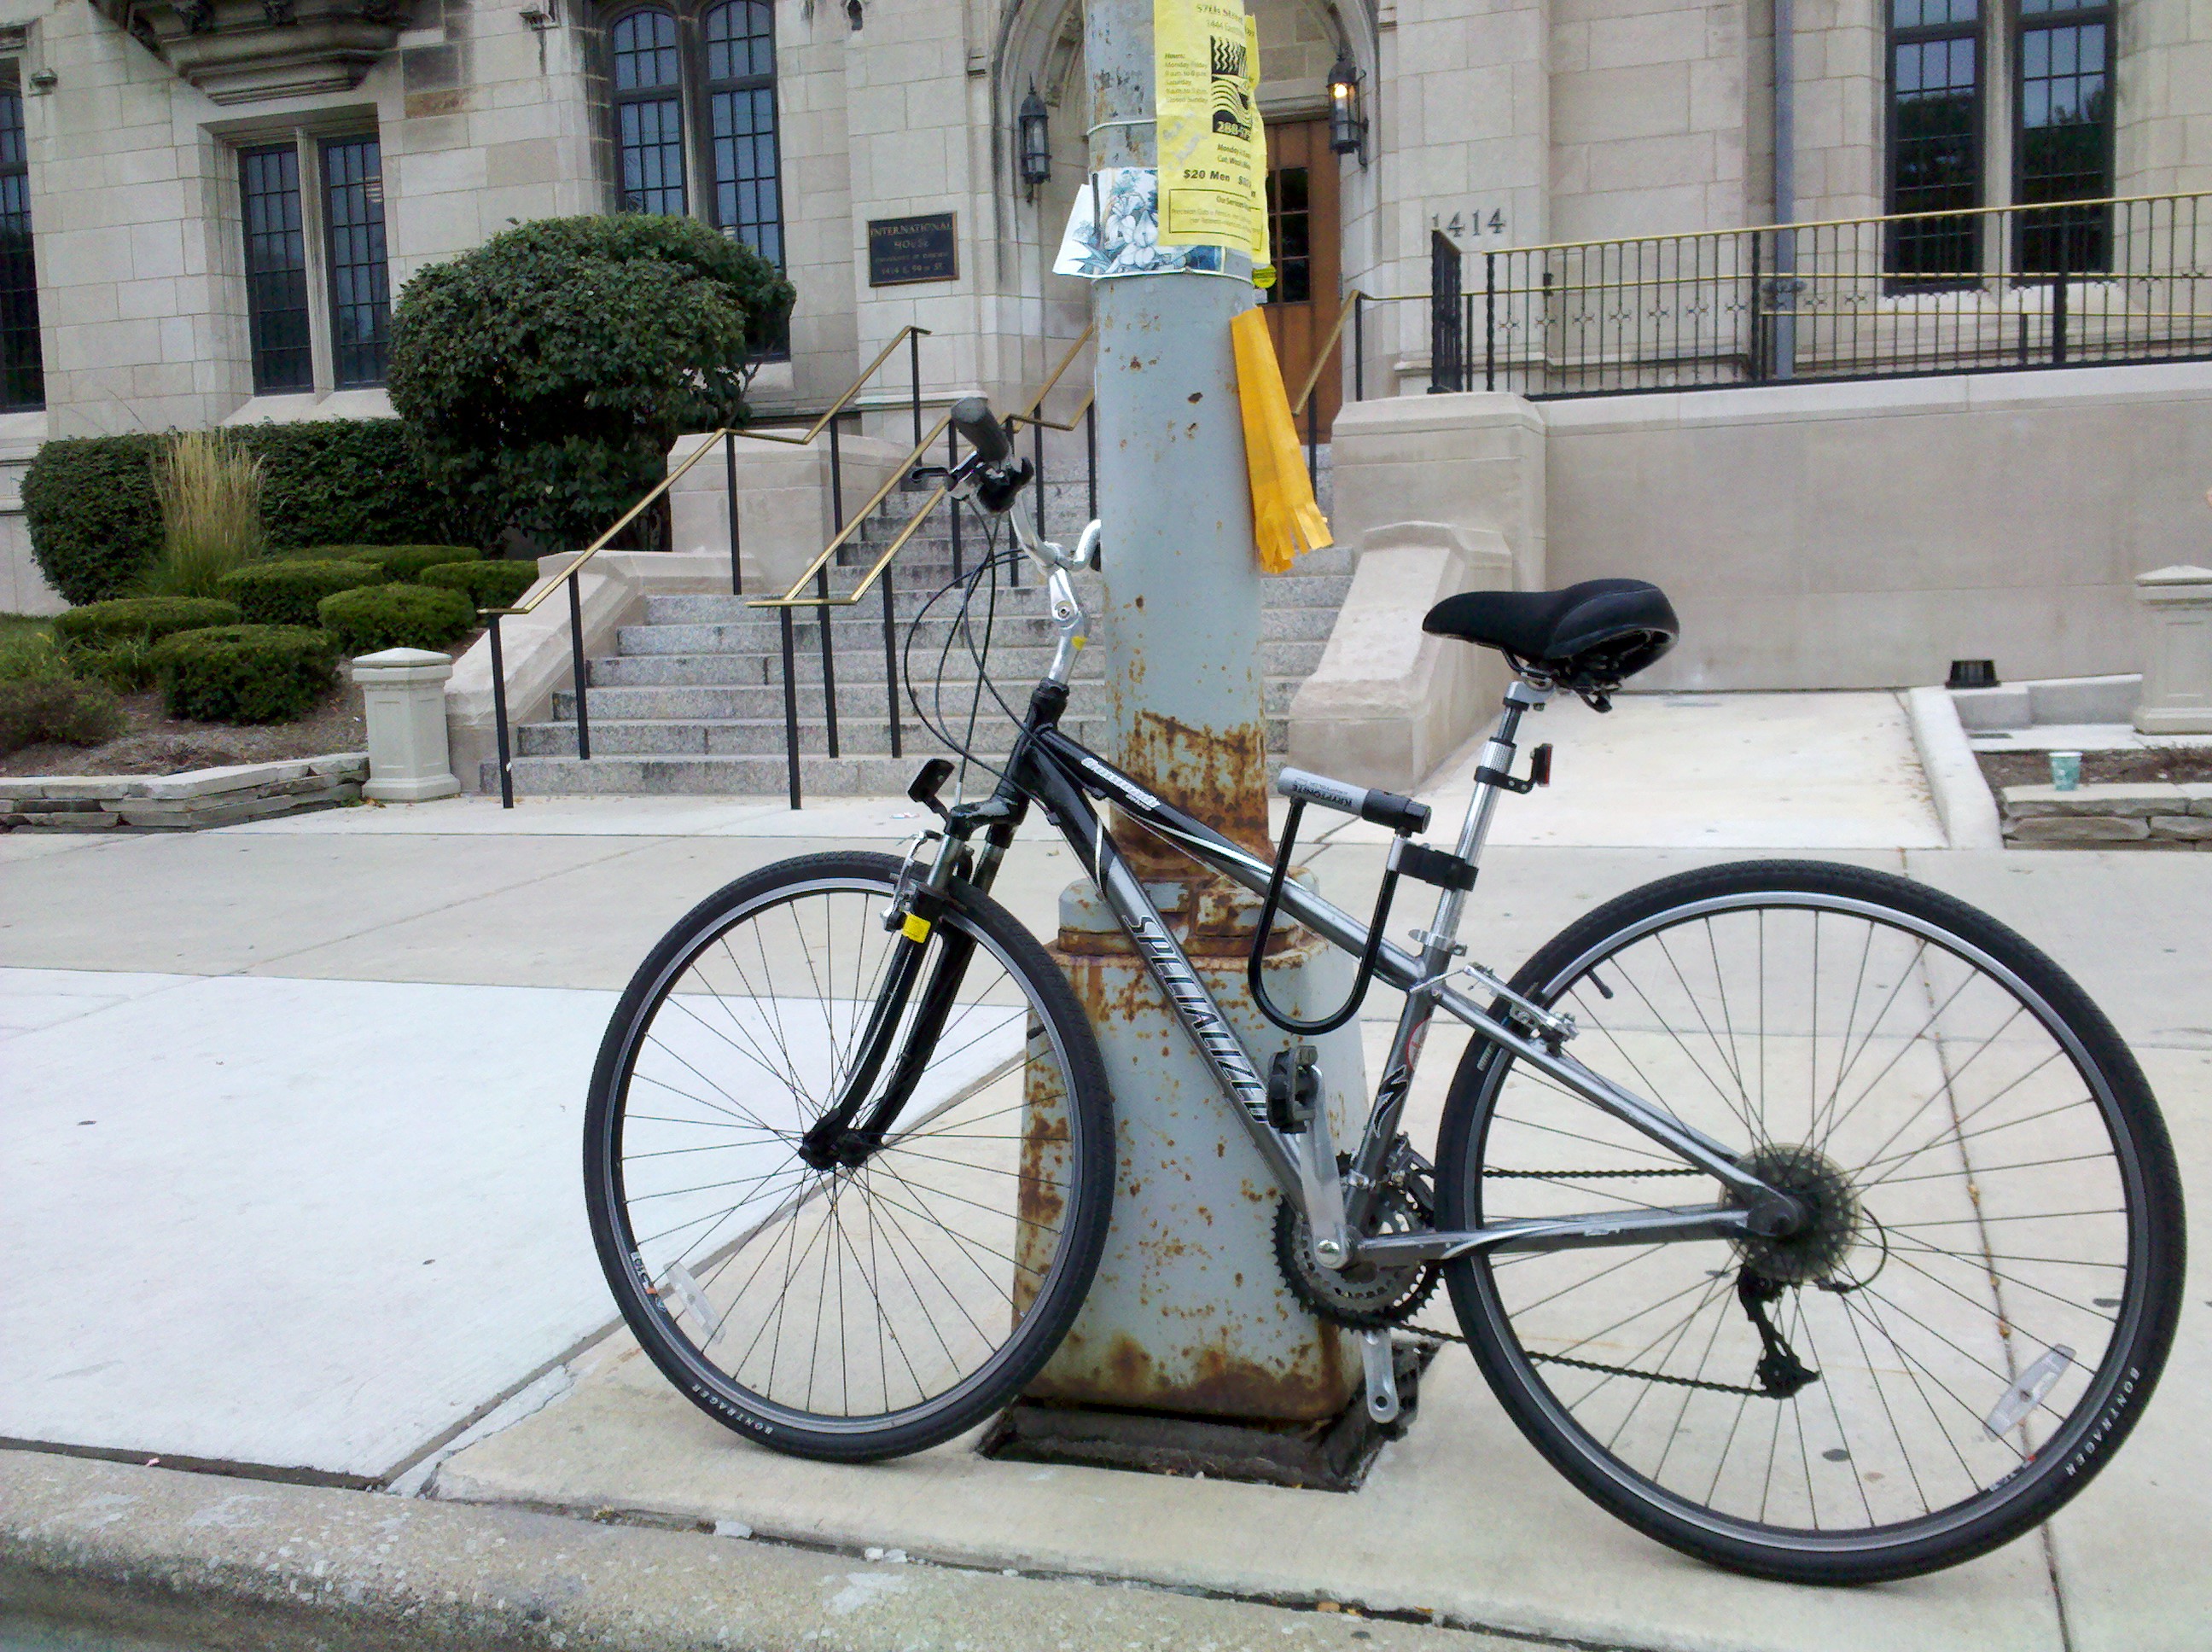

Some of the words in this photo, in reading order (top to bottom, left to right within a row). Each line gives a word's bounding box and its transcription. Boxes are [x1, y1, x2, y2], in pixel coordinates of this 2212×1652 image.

[1184, 169, 1206, 180] $20
[1210, 171, 1231, 183] Men
[870, 223, 953, 237] INTERNATIONAL
[1121, 914, 1271, 1124] SPECIALIZED
[691, 1384, 773, 1434] BONTRAGER
[2064, 1367, 2140, 1476] BONTRAGER
